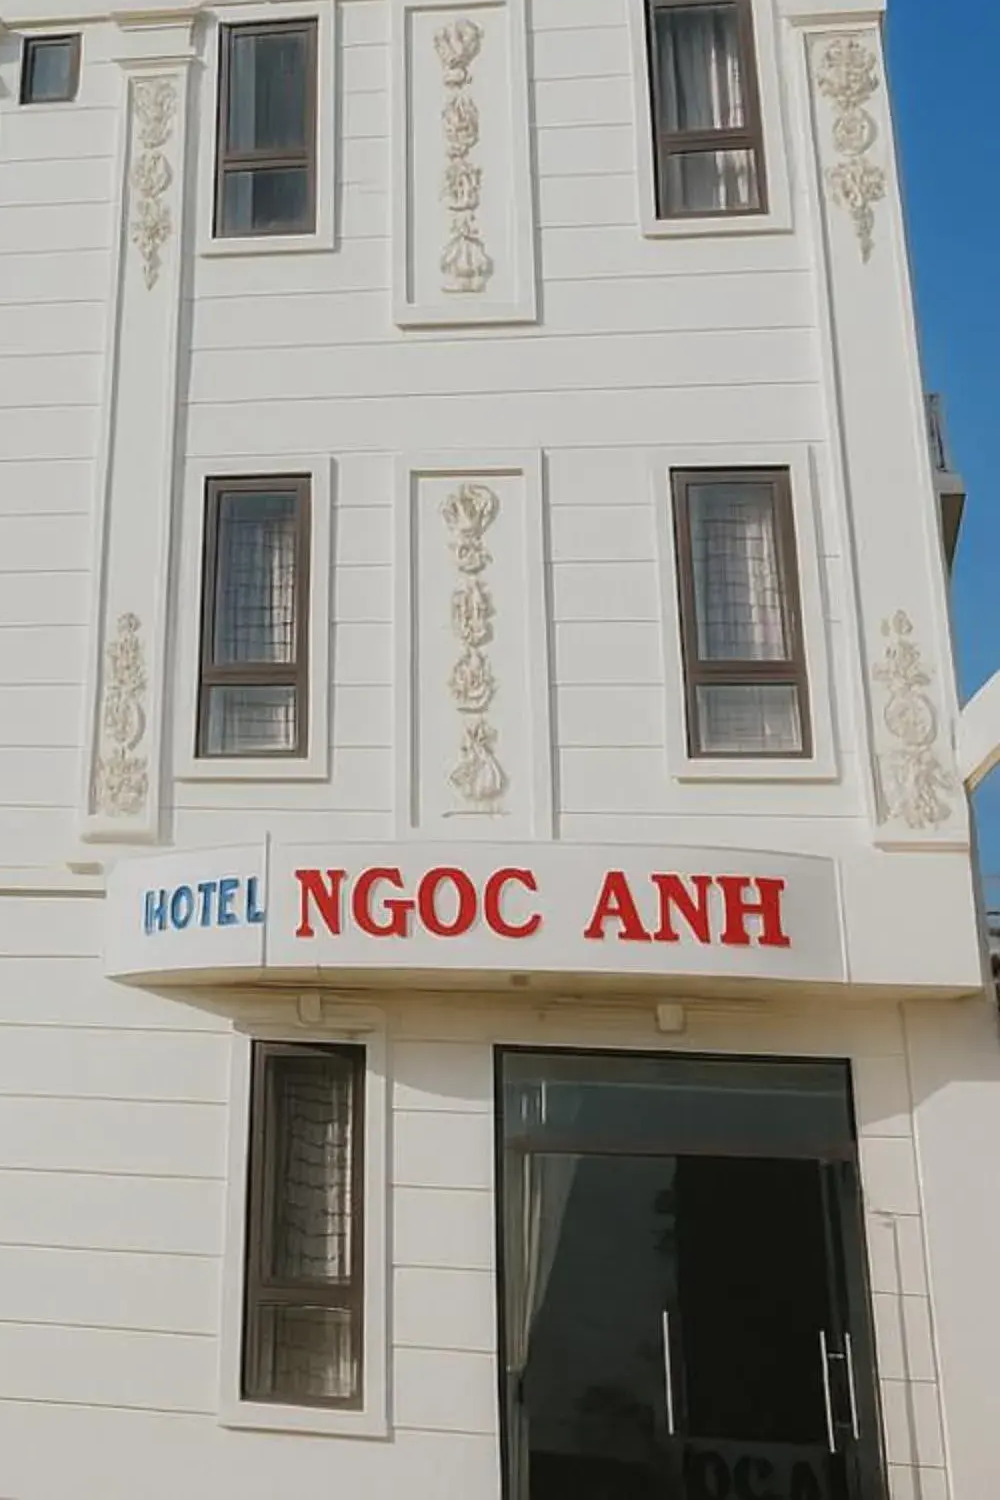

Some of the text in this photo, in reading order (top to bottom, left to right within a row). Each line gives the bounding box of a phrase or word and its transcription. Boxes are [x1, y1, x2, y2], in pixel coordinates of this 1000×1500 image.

[143, 866, 793, 948] HOTEL NGOC ANH
